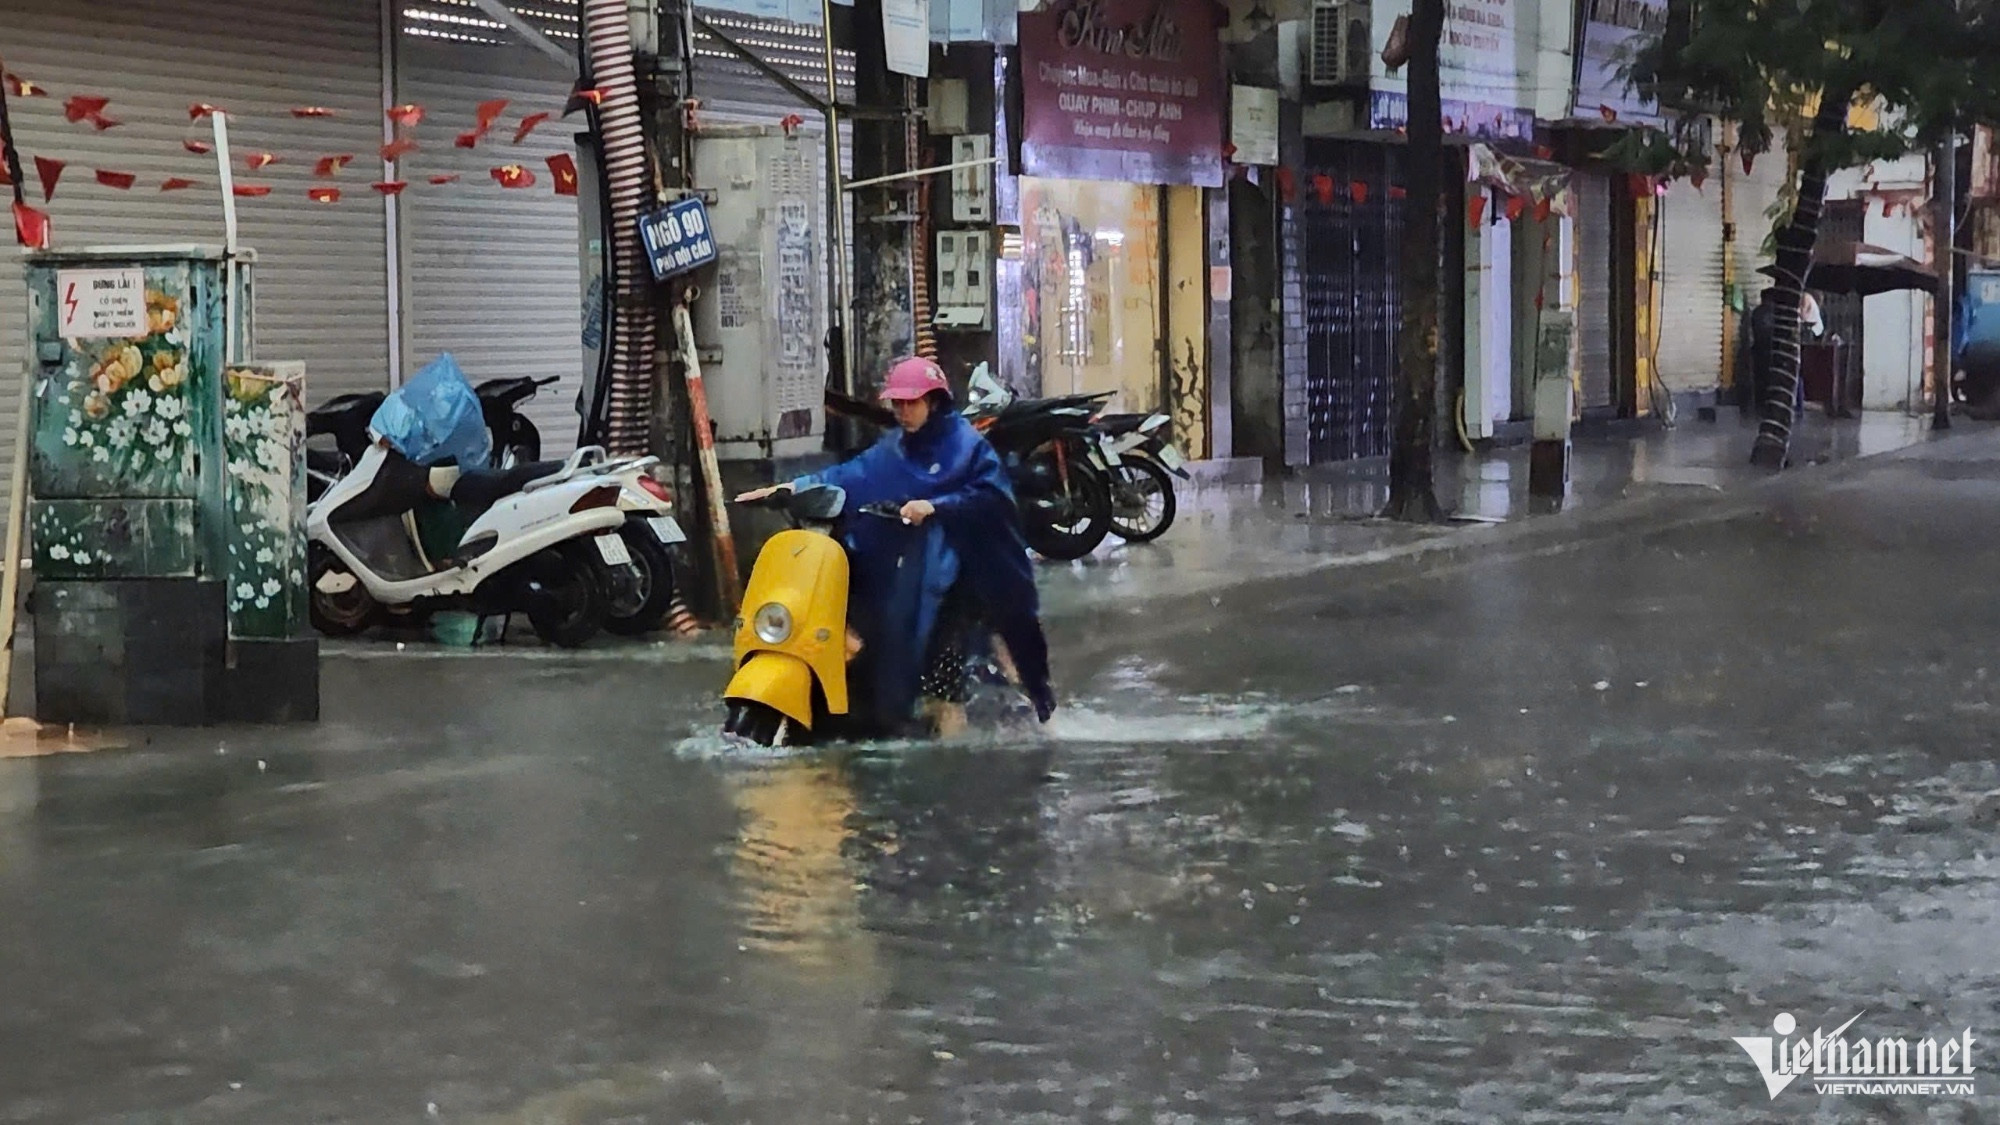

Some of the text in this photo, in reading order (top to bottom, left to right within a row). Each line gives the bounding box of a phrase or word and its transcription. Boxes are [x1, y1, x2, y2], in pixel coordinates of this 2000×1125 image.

[1059, 92, 1090, 115] QUAY
[647, 208, 705, 251] NGÕ 90
[656, 250, 676, 274] PHỐ
[675, 246, 692, 266] ĐỘI
